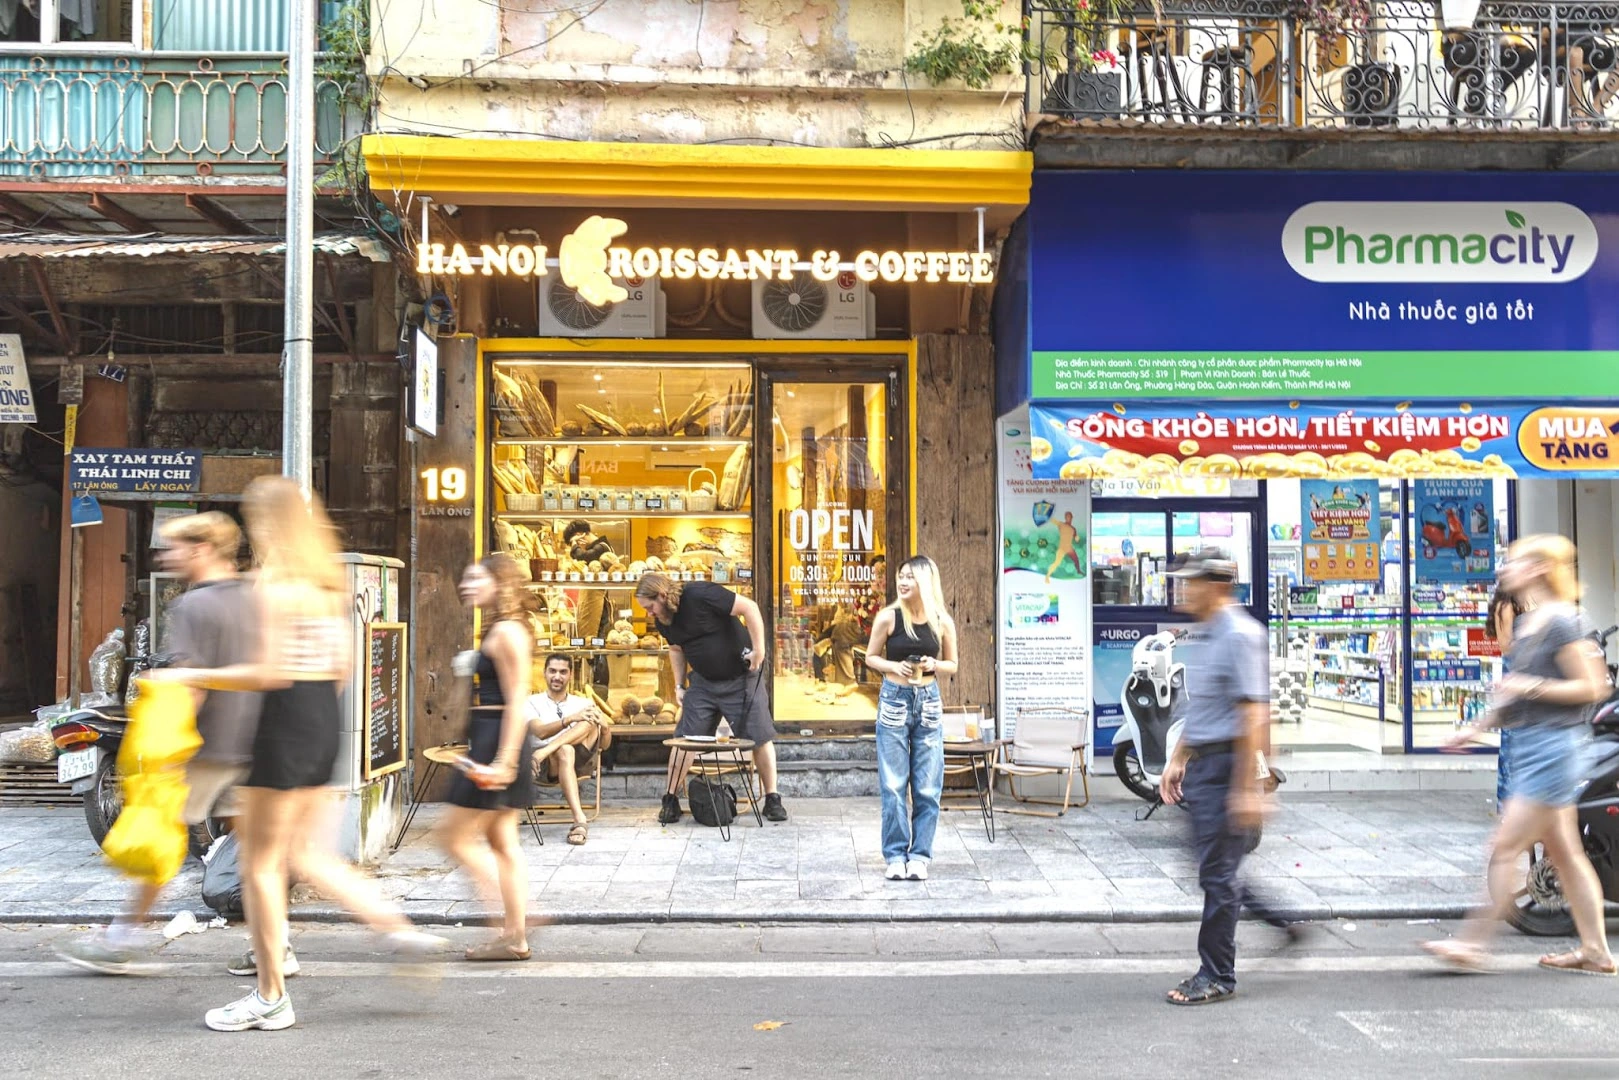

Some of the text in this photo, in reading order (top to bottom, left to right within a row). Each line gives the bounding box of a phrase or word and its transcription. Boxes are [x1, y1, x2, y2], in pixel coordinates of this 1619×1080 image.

[1304, 216, 1575, 273] Pharmacity
[416, 243, 473, 276] HA
[480, 244, 547, 276] NOI
[811, 250, 840, 281] &
[854, 250, 995, 284] COFFEE
[628, 290, 643, 300] LG
[840, 292, 855, 302] LG
[1349, 298, 1534, 324] Nhà thuốc giá tốt
[1091, 358, 1106, 368] kinh
[1108, 358, 1132, 368] doanh
[1282, 358, 1324, 368] Pharmacity
[1056, 370, 1071, 378] Nhà
[1097, 370, 1139, 380] Pharmacity
[1213, 370, 1230, 378] Kinh
[1231, 370, 1256, 378] Doanh
[1100, 382, 1108, 390] 21
[1066, 410, 1509, 442] SỐNG KHỎE HƠN, TIẾT KIỆM HƠN
[1538, 417, 1608, 438] MUA
[1540, 439, 1609, 464] TẶNG
[73, 452, 196, 465] XAY TAM THẤT
[78, 466, 191, 479] THÁI LINH CHI
[100, 481, 118, 489] ÔNG
[135, 481, 192, 491] LẤY NGAY
[421, 466, 467, 501] 19
[447, 504, 471, 516] ÔNG
[789, 509, 874, 550] OPEN
[790, 566, 820, 581] 06.30
[842, 566, 871, 581] 10.00
[1292, 592, 1316, 603] 24/7
[1108, 630, 1140, 640] URGO
